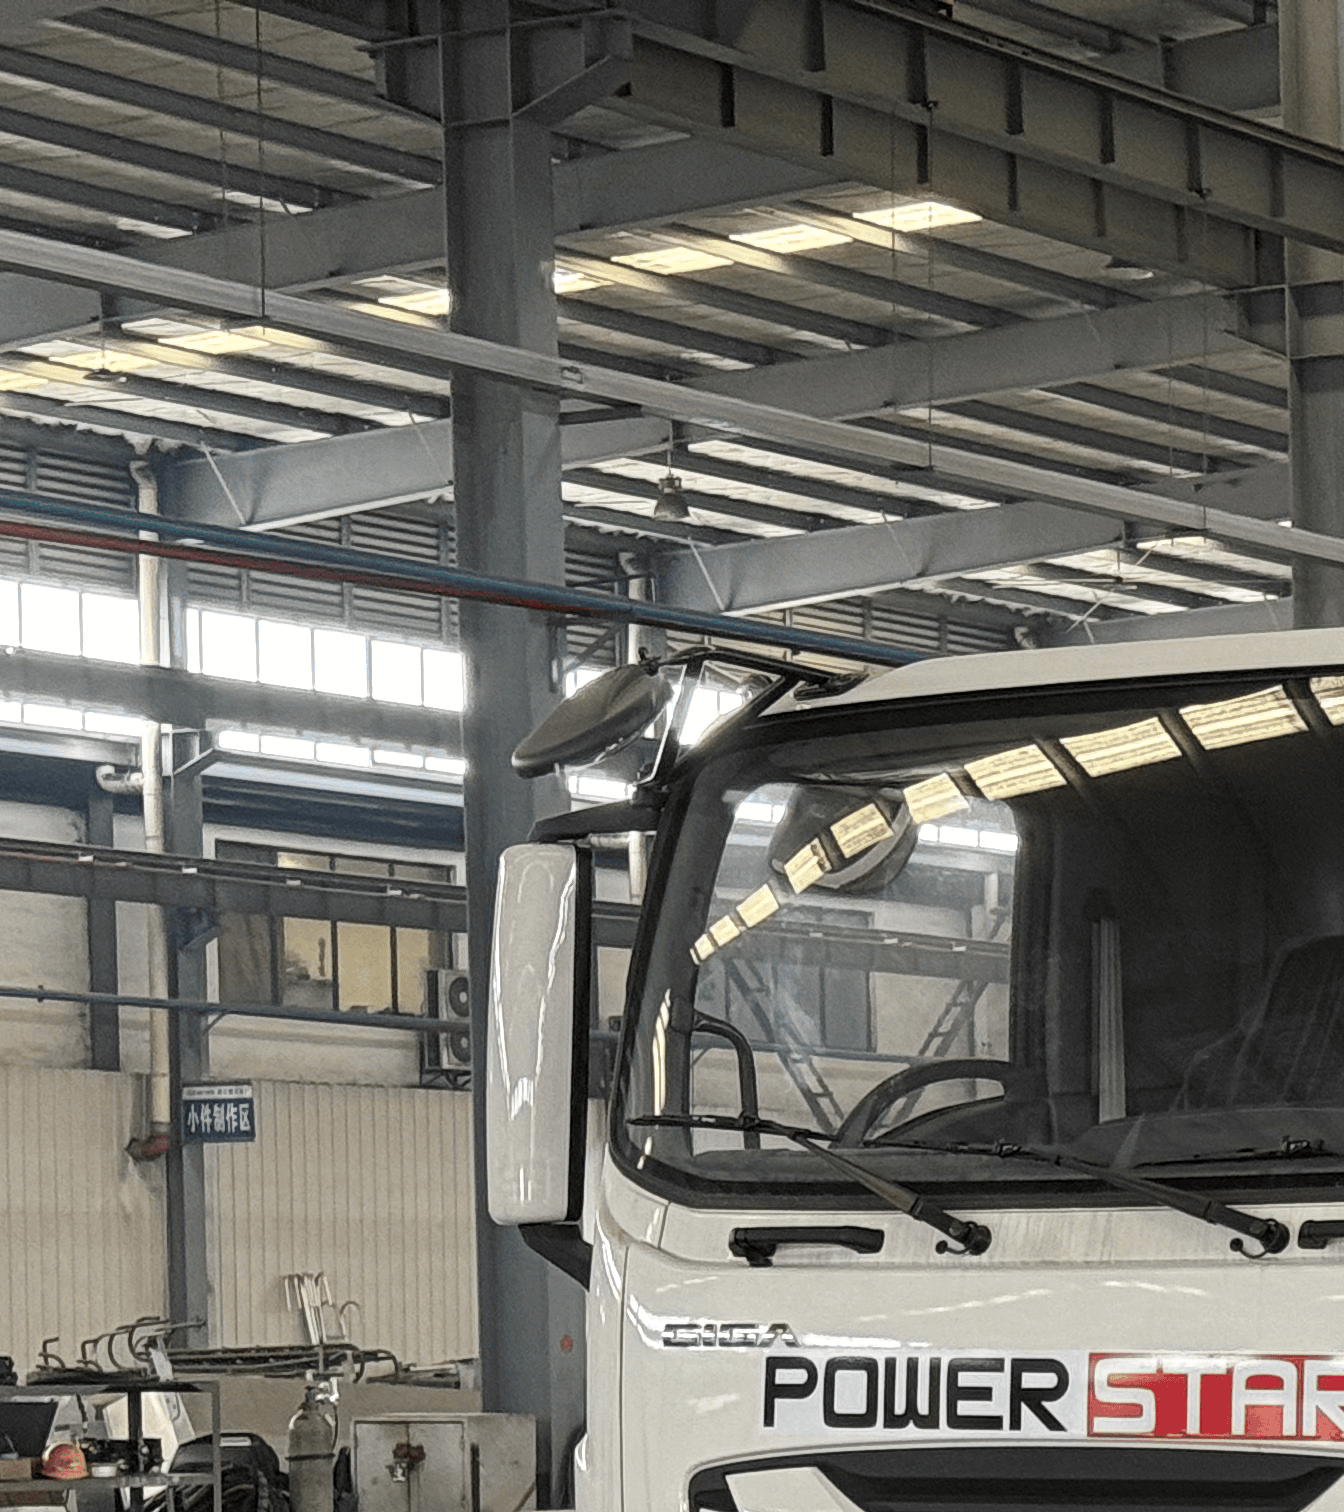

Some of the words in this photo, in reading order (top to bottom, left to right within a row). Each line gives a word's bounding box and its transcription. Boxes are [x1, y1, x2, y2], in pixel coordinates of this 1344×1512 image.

[187, 1103, 251, 1133] 小件制作区
[661, 1323, 800, 1347] GIGA
